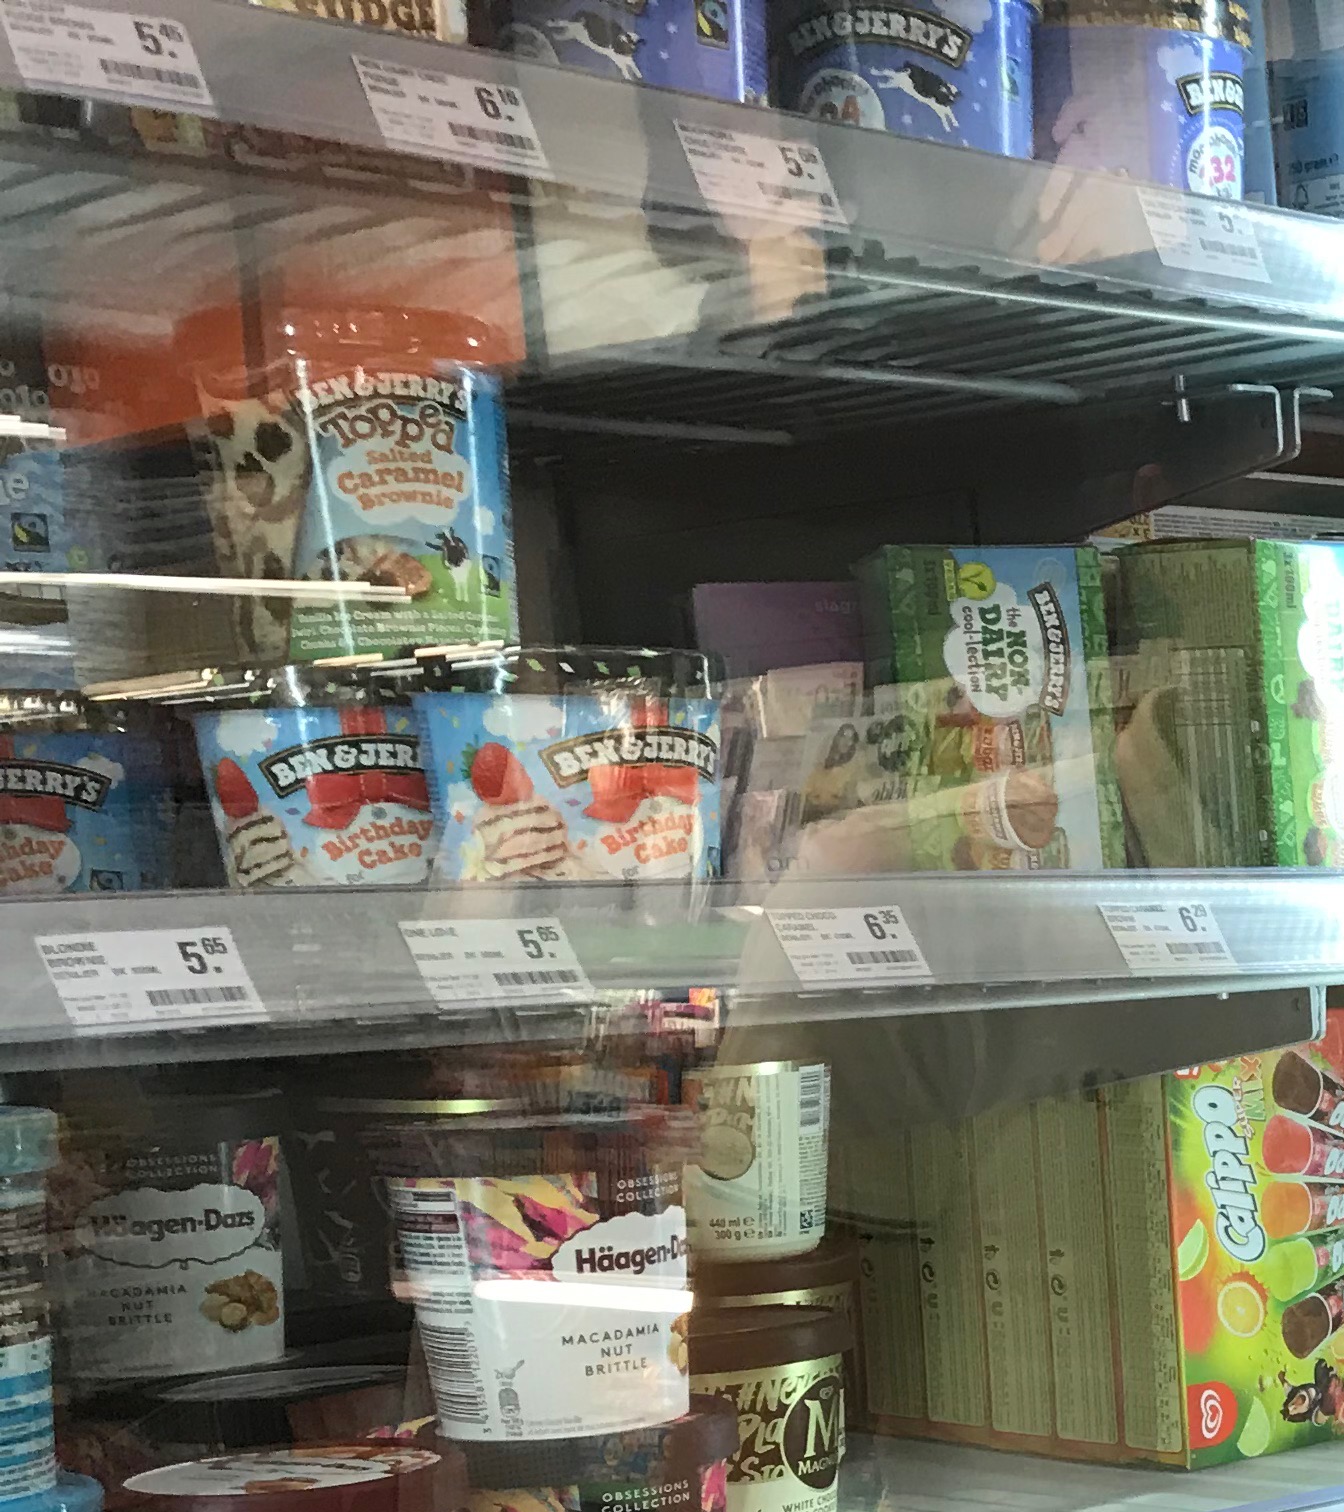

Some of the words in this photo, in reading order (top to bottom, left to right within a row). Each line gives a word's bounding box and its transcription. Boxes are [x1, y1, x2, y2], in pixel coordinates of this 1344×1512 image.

[319, 401, 455, 455] Topped
[366, 447, 433, 465] Salted
[337, 466, 464, 494] Caramel
[357, 489, 455, 512] Brownie
[1006, 606, 1022, 628] the
[962, 605, 982, 694] cool-lection
[978, 603, 1008, 702] DAIRY
[1006, 629, 1031, 697] NON-
[1033, 589, 1067, 708] BEN&JERRY'S
[553, 735, 718, 779] BEN&JERRY'S
[0, 768, 100, 802] ERRY'S
[321, 814, 434, 861] Birthday
[600, 811, 697, 855] Birthday
[357, 840, 423, 871] Cake
[634, 838, 689, 866] Cake
[863, 909, 899, 940] 6.35
[175, 937, 229, 975] 5.65
[516, 925, 560, 959] 5.65
[616, 1173, 678, 1190] OBSESSIONS
[1192, 1084, 1266, 1263] Calippo
[616, 1184, 679, 1203] COLLECTION
[91, 1208, 255, 1242] Häagen-Dazs
[108, 1313, 173, 1326] BRITTLE
[121, 1300, 154, 1312] NUT
[561, 1323, 660, 1346] MACADAMIA
[600, 1343, 633, 1358] NUT
[584, 1357, 648, 1377] BRITTLE
[602, 1479, 690, 1503] OBSESSIONS
